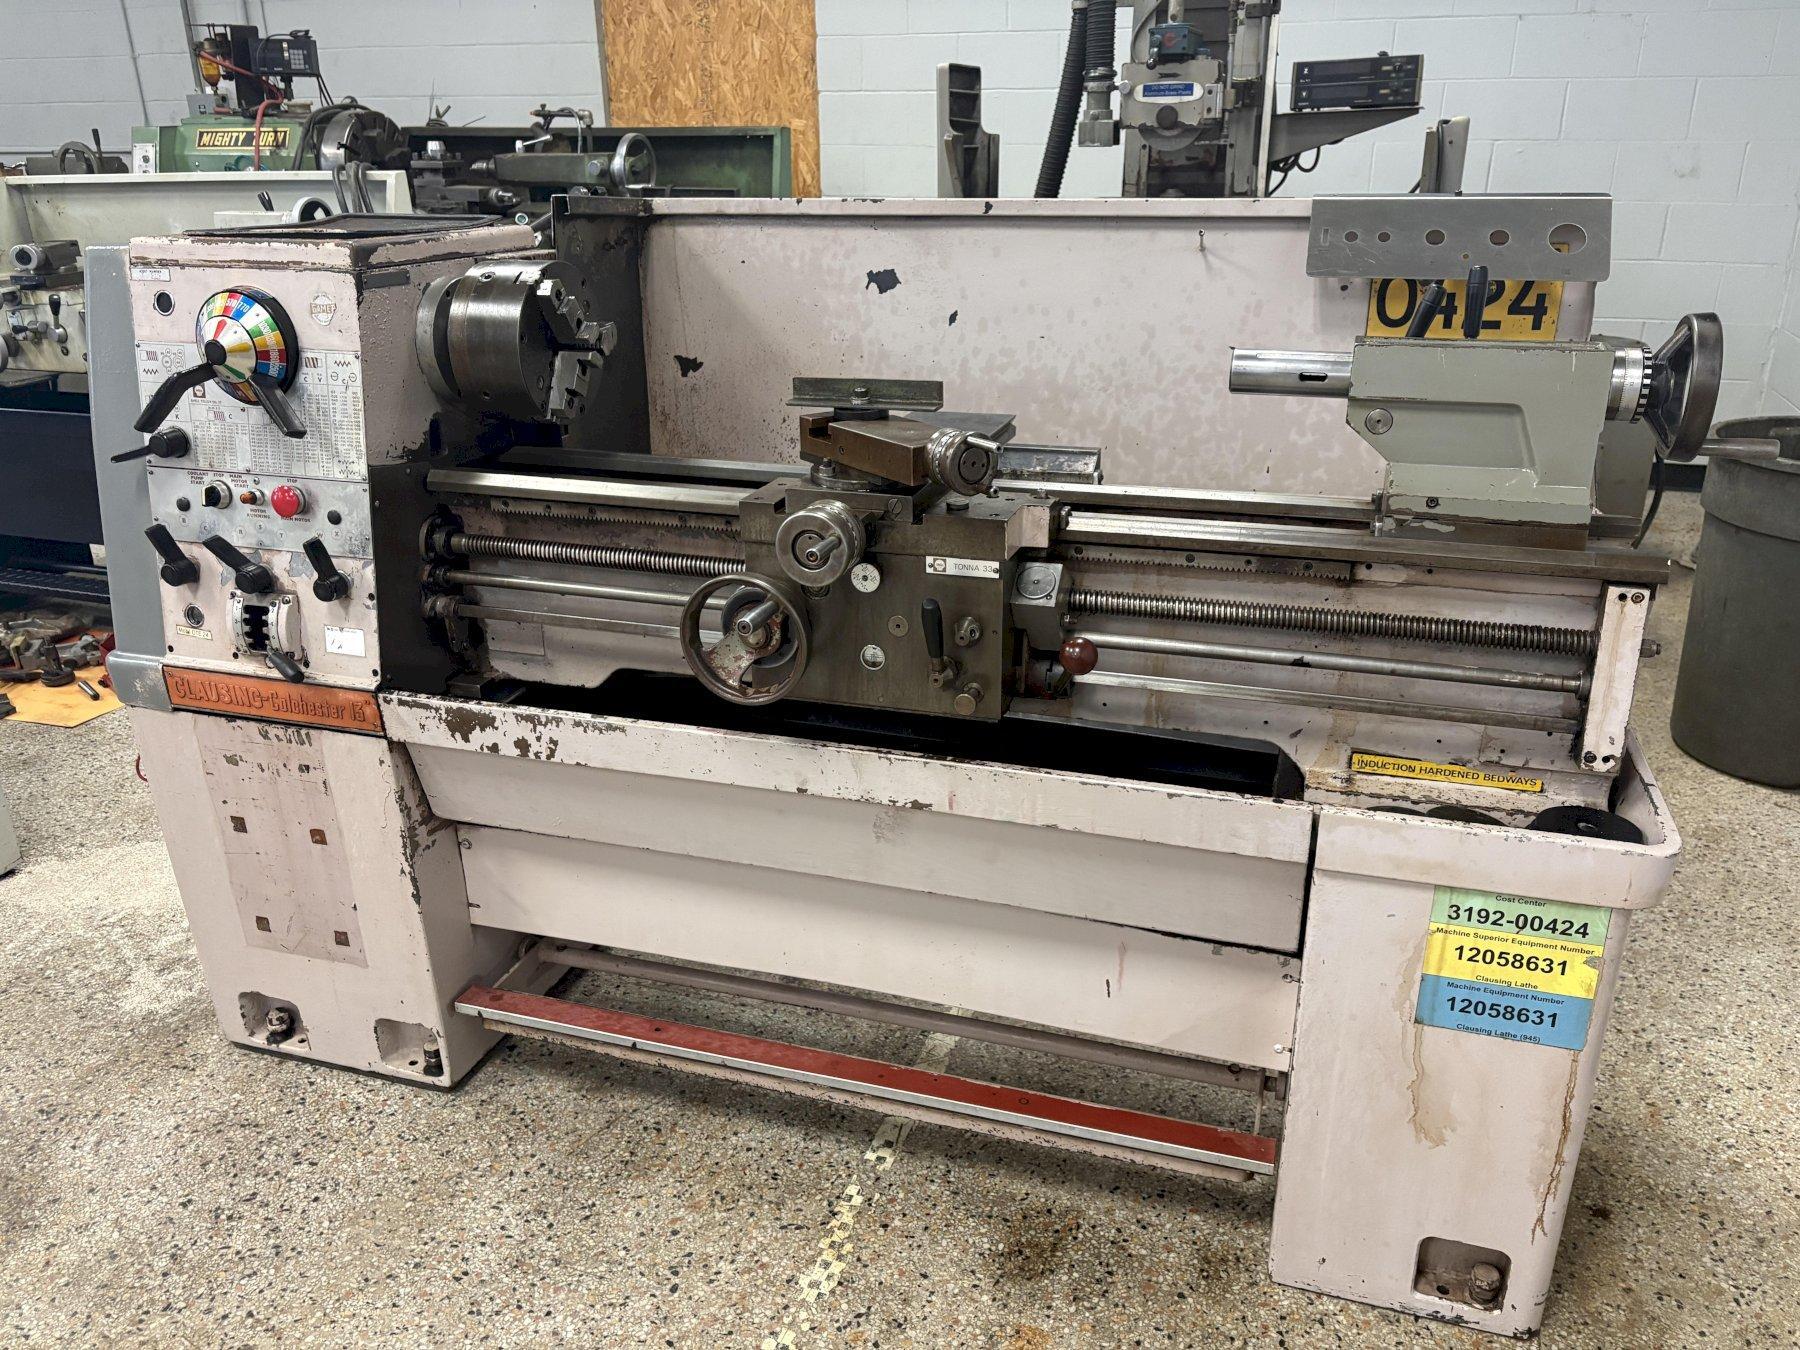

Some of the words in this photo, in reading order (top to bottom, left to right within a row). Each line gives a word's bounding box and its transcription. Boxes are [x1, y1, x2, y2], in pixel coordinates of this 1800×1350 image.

[200, 132, 246, 146] MIGHTY
[953, 562, 980, 572] TONNA
[1357, 758, 1416, 772] INDUCTION
[1419, 766, 1480, 780] HARDENED
[1483, 773, 1537, 786] BEDWAYS
[1495, 895, 1516, 905] Cost
[1518, 897, 1547, 908] Center
[1447, 904, 1589, 939] 3192-00424
[1436, 927, 1470, 938] Machine
[1472, 932, 1509, 944] Superior
[1512, 937, 1558, 951] Equipment
[1560, 944, 1595, 956] Number
[1454, 945, 1568, 976] 12058631
[1446, 981, 1480, 992] Machine
[1483, 986, 1528, 1000] Equipment
[1530, 994, 1564, 1006] Number
[1476, 974, 1512, 988] Clausing
[1514, 981, 1538, 990] Lathe
[1446, 996, 1558, 1028] 12058631
[1456, 1023, 1492, 1036] Clausing
[1494, 1029, 1518, 1039] Lathe
[1520, 1033, 1540, 1044] (945)
